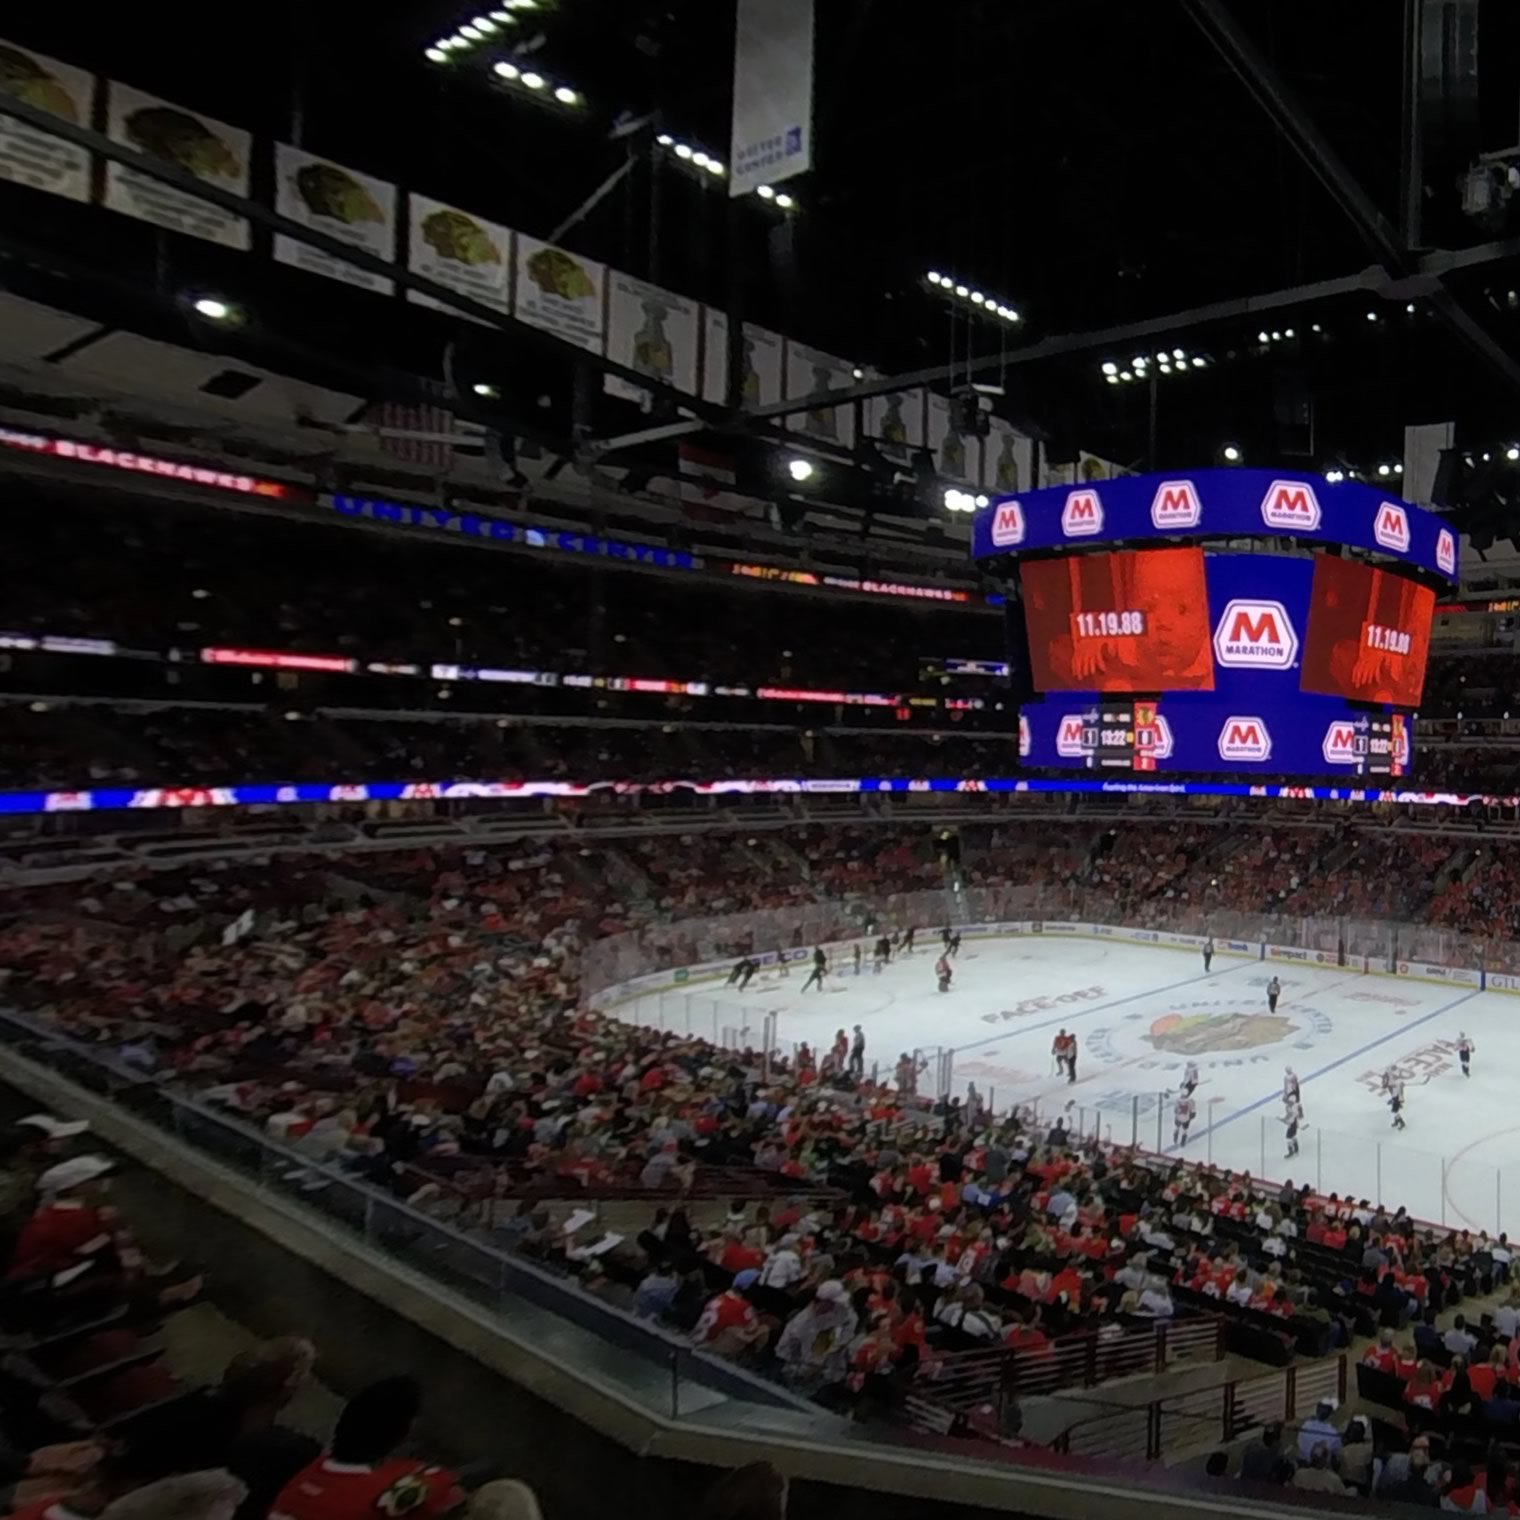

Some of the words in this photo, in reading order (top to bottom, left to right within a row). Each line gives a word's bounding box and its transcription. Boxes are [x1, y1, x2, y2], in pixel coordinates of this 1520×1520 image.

[55, 440, 252, 492] BLACKHAWKS
[333, 493, 517, 541] UNITED
[558, 531, 695, 570] CENTER
[1076, 610, 1143, 637] 11.19.88
[1228, 612, 1281, 644] M
[1225, 645, 1284, 657] MARATHON
